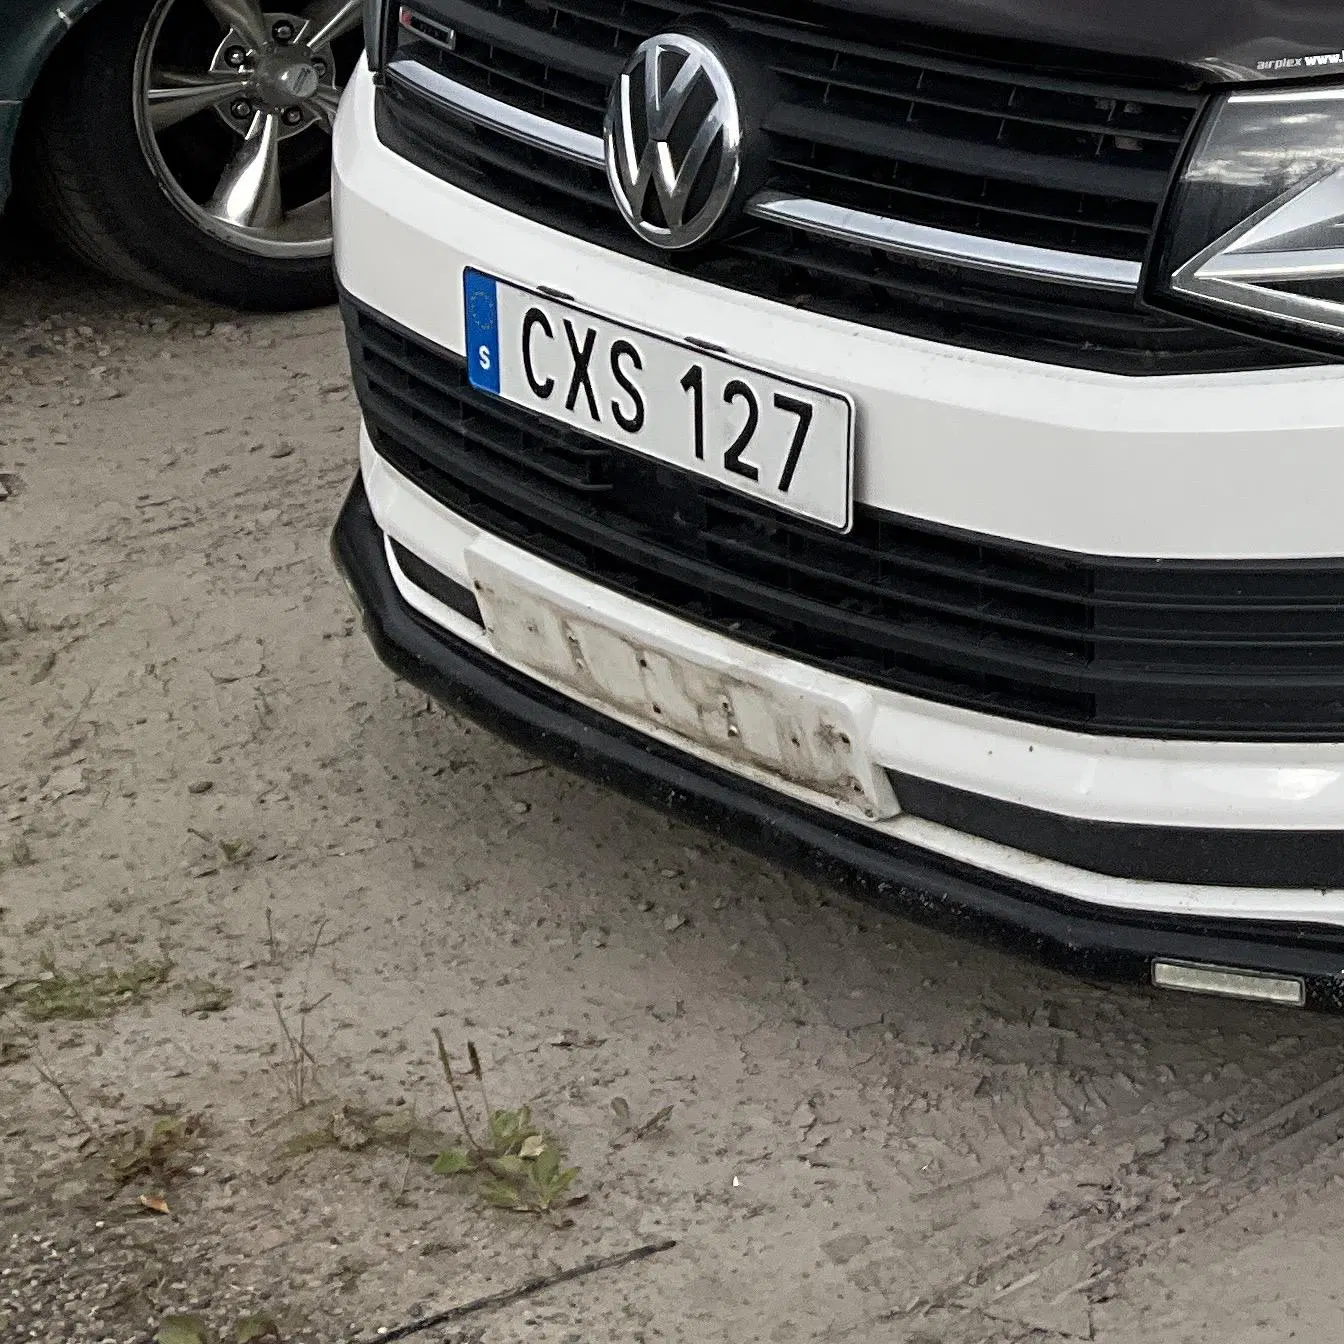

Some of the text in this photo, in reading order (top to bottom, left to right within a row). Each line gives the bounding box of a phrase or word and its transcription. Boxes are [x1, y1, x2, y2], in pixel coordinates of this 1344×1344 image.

[1256, 57, 1302, 70] airplex
[479, 345, 491, 370] S
[521, 307, 814, 493] CXS 127
